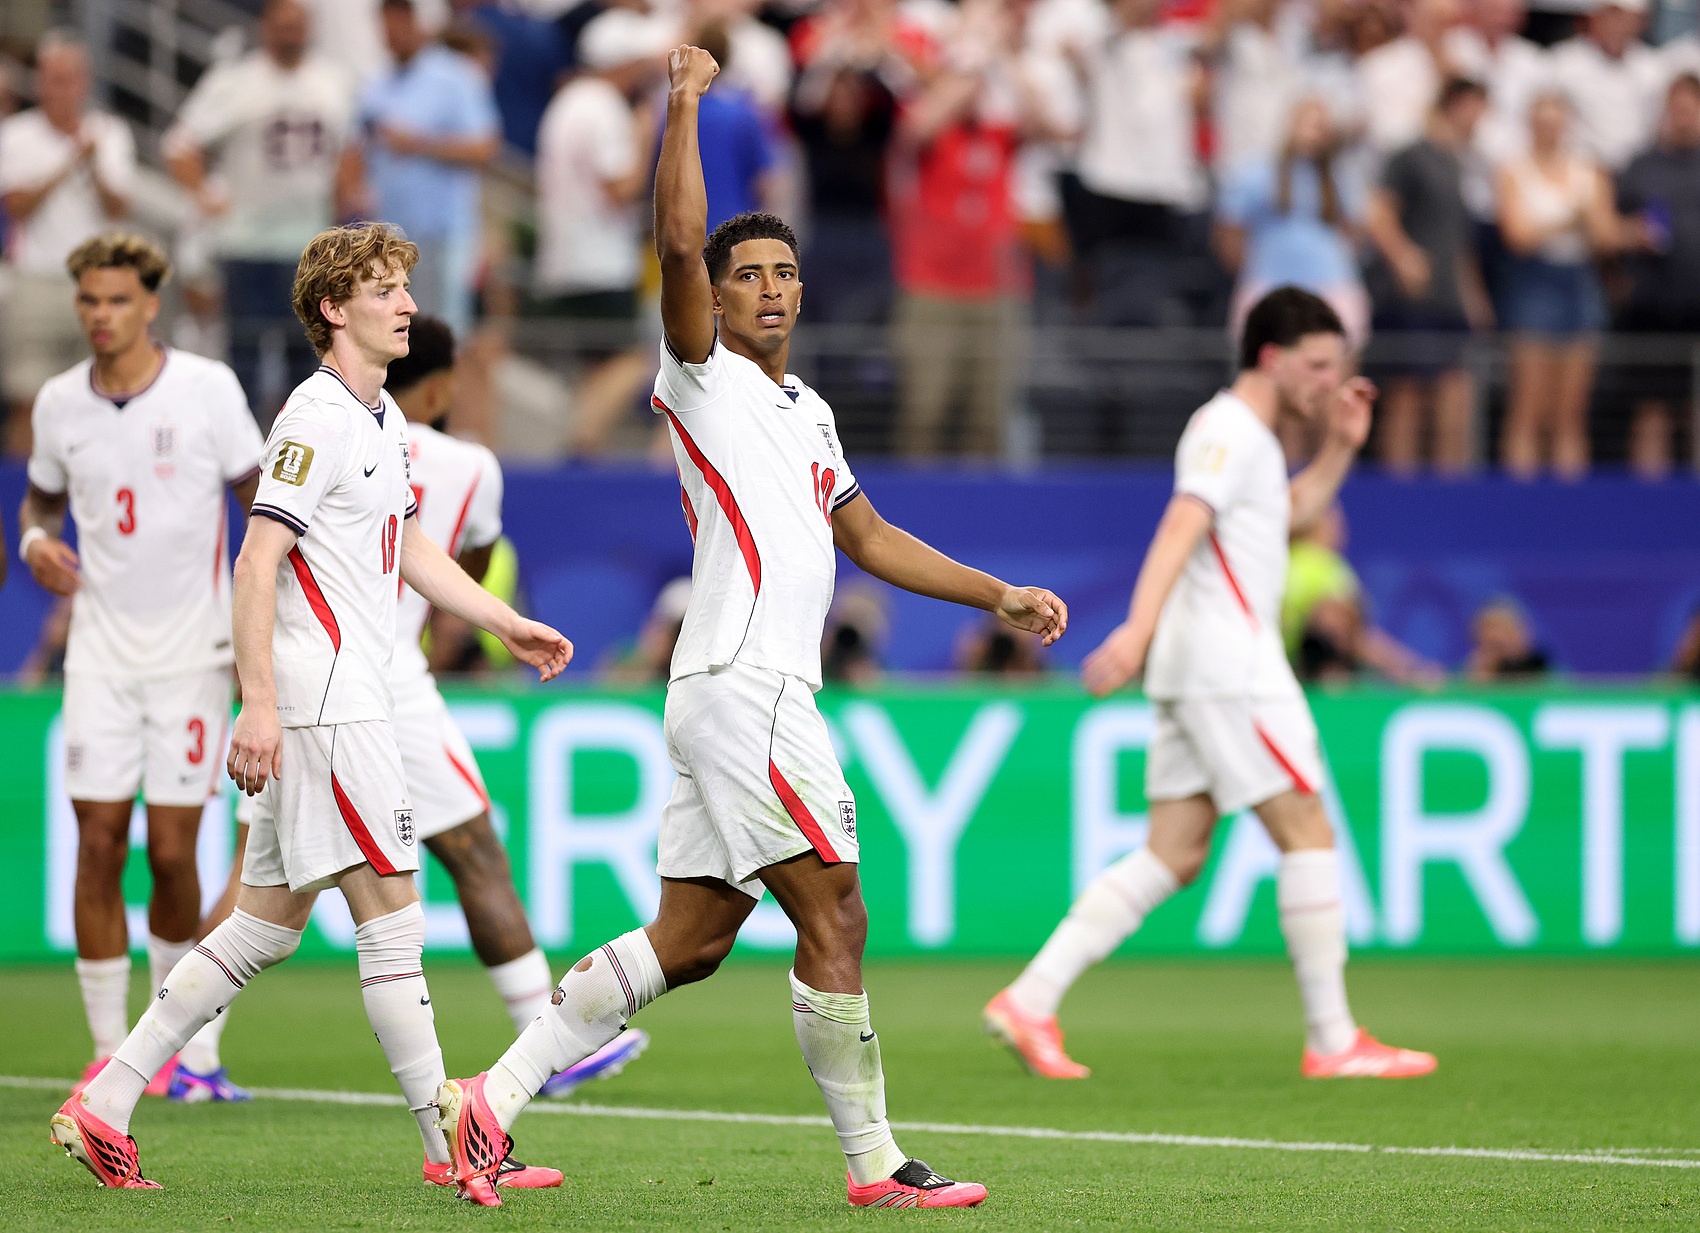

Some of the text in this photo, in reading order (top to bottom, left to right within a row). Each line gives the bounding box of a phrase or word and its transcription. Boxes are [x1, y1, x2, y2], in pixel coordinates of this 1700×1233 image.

[116, 487, 136, 536] 3
[811, 461, 836, 528] 10
[381, 514, 398, 575] 18
[187, 717, 205, 767] 3
[1071, 703, 1700, 947] PART
